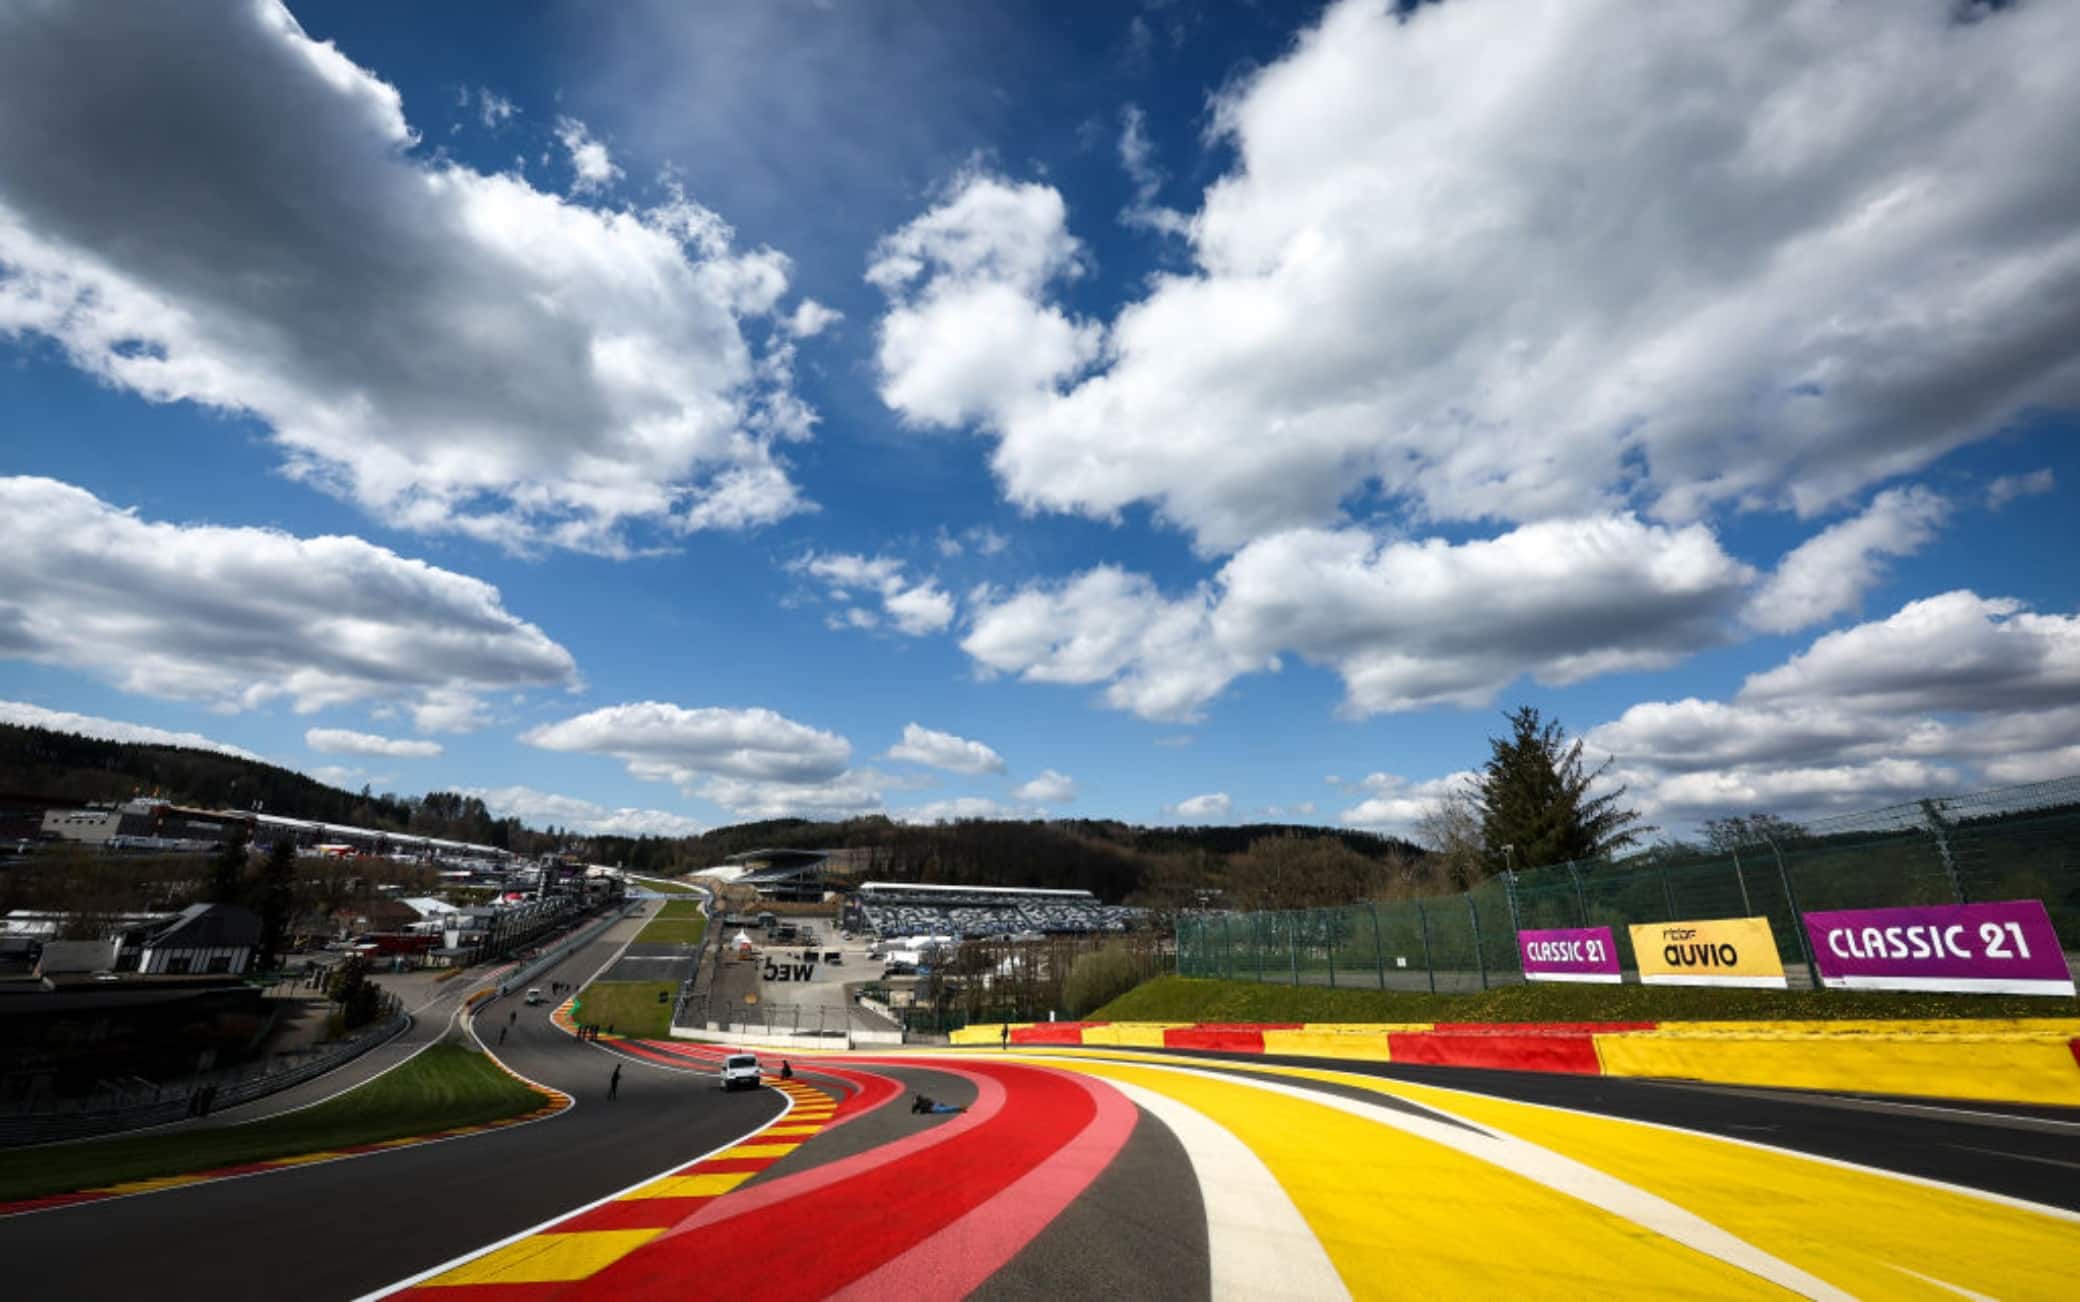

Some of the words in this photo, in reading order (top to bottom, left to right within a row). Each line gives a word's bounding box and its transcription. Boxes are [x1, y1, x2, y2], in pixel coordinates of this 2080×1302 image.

[1526, 941, 1585, 962] CLASSIC
[1585, 939, 1607, 962] 21
[1828, 925, 1971, 959] CLASSIC
[1979, 922, 2031, 959] 21
